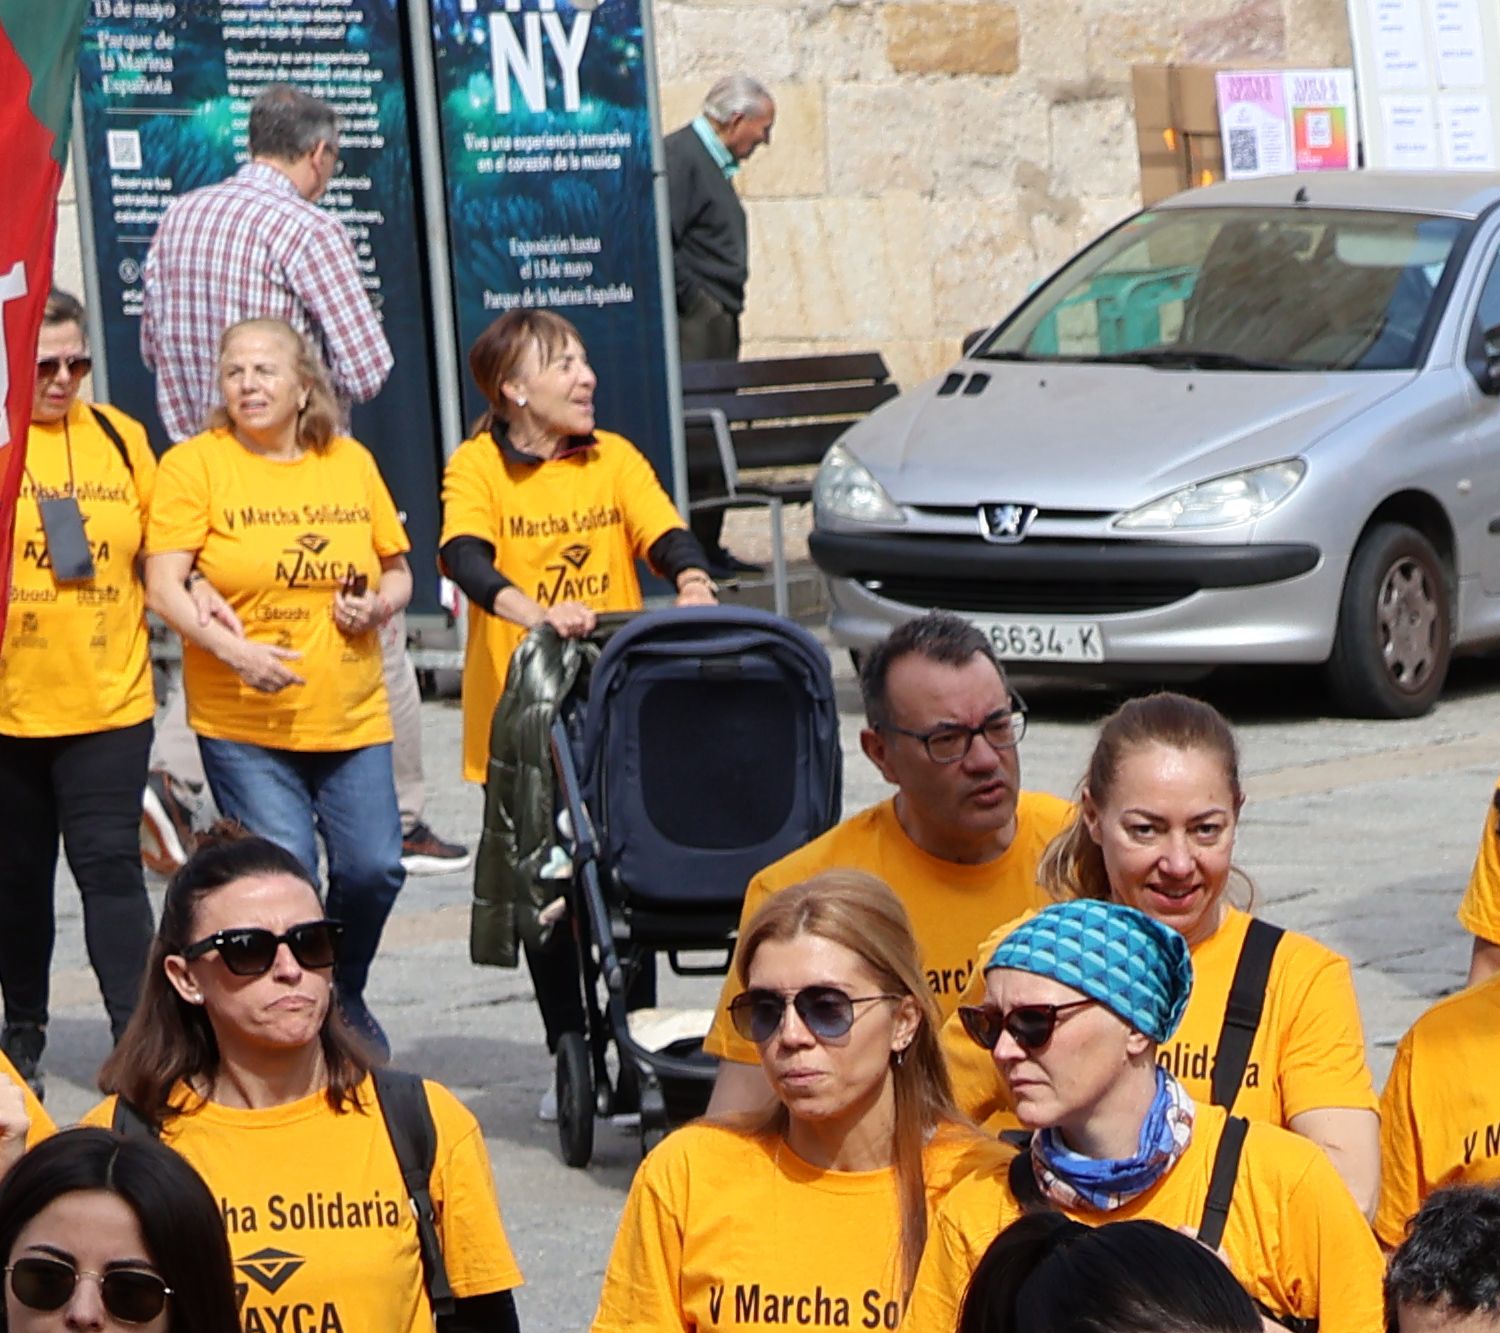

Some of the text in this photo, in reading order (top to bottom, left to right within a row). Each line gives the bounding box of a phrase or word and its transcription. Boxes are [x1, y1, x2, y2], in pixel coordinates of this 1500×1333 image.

[97, 31, 175, 52] Parque de
[99, 53, 174, 72] la Marina
[489, 12, 592, 113] NY
[102, 76, 174, 96] Española
[238, 507, 298, 530] Marcha
[508, 510, 570, 536] Marcha
[535, 566, 610, 613] AZAYCA
[269, 1192, 400, 1233] Solidaria
[735, 1286, 850, 1328] Marcha
